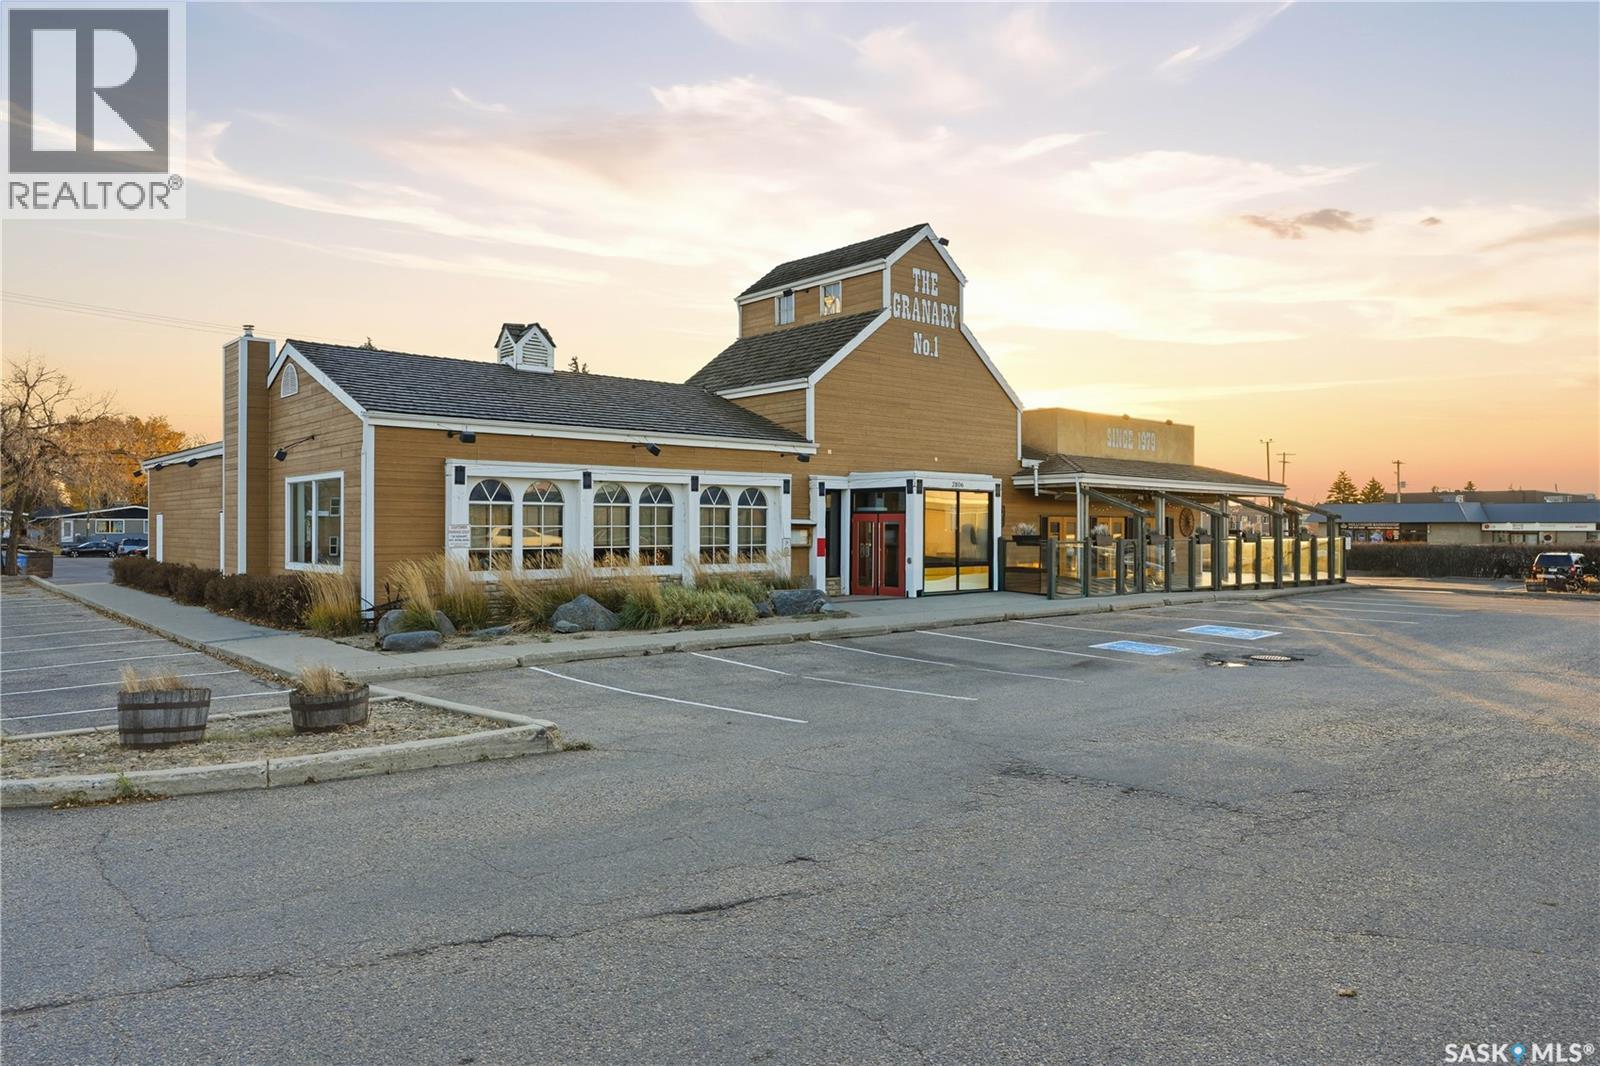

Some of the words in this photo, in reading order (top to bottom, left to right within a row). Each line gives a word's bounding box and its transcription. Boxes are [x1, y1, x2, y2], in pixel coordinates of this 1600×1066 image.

[912, 267, 939, 296] THE
[893, 292, 957, 329] GRANARY
[913, 332, 939, 357] No.1
[1106, 427, 1134, 449] SINCE
